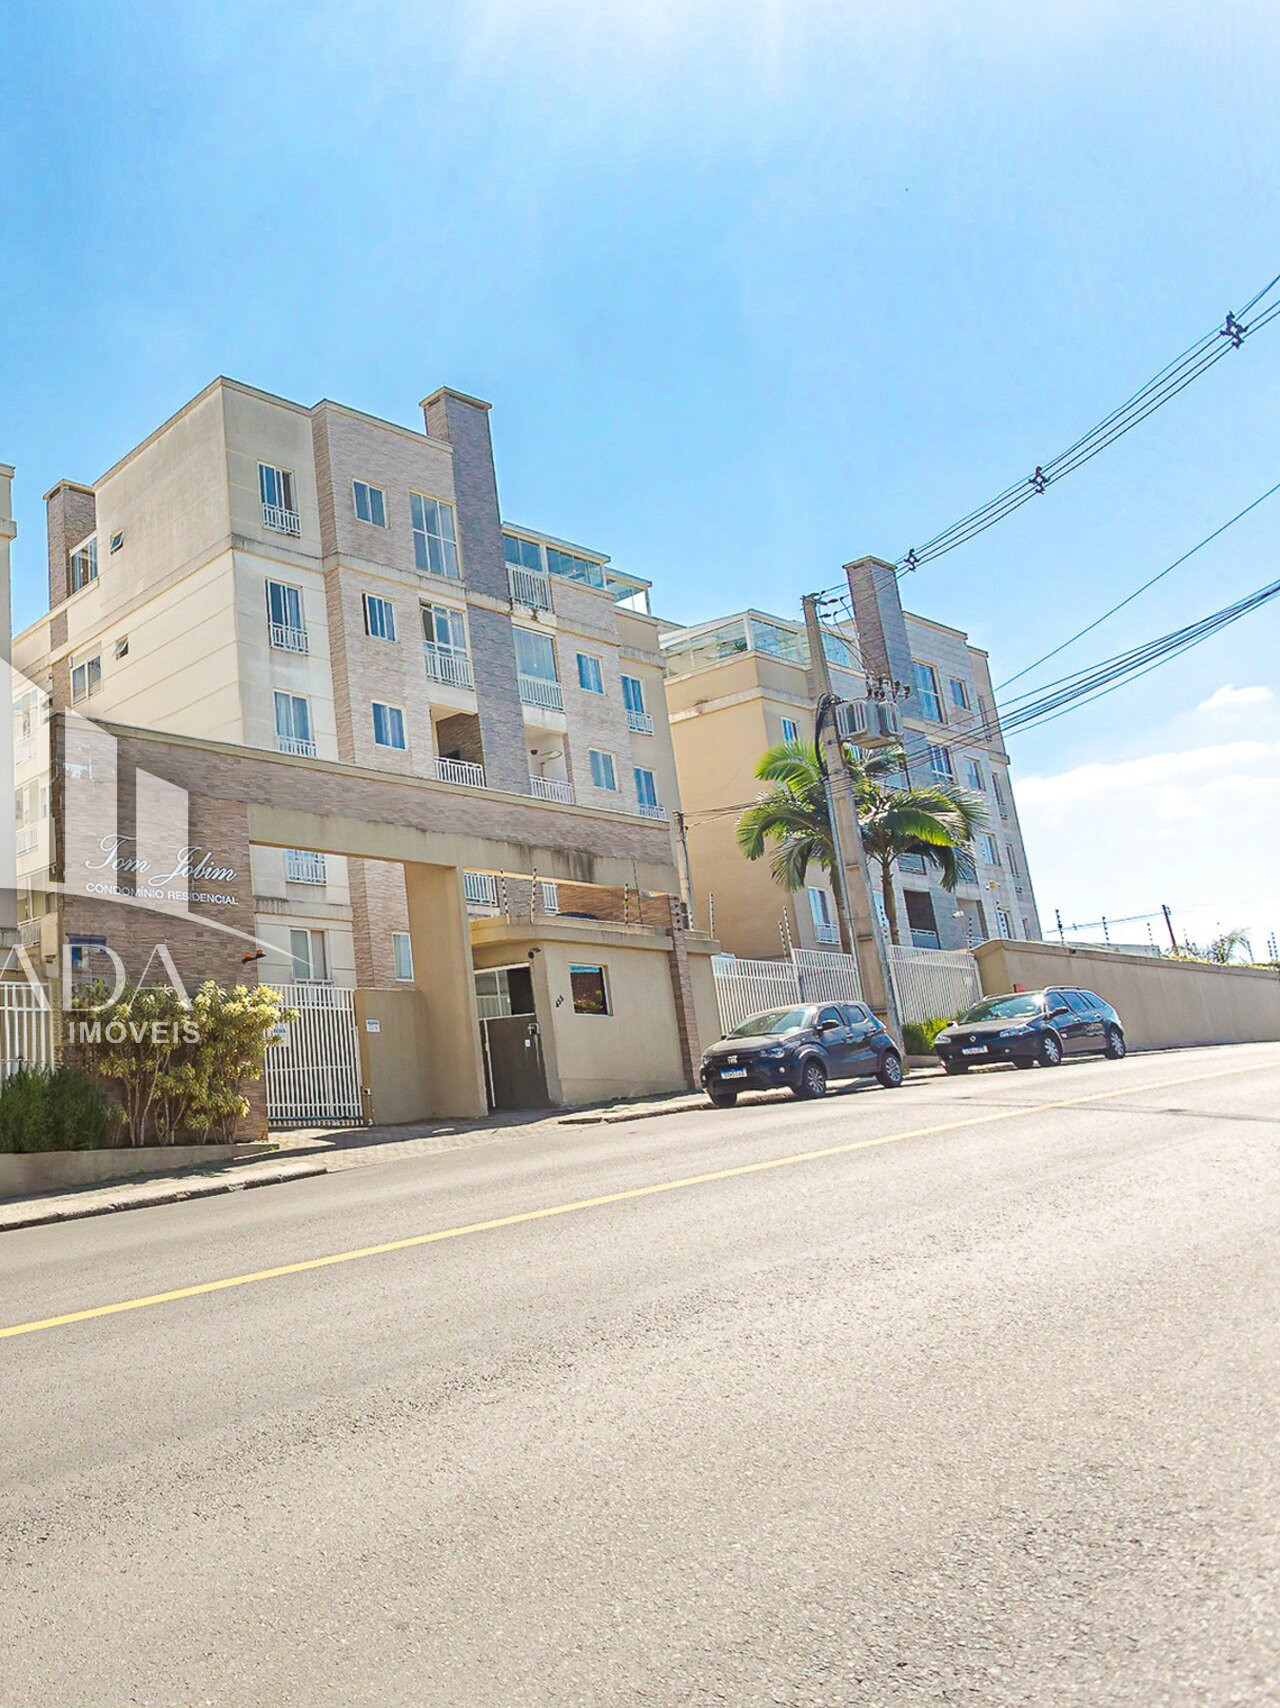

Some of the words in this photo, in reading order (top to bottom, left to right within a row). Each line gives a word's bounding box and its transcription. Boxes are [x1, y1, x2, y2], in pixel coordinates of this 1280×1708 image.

[84, 834, 151, 872] Tom
[148, 846, 238, 887] Jobim
[85, 883, 164, 898] CONDOMÍNIO
[167, 890, 239, 905] RESIDENCIAL
